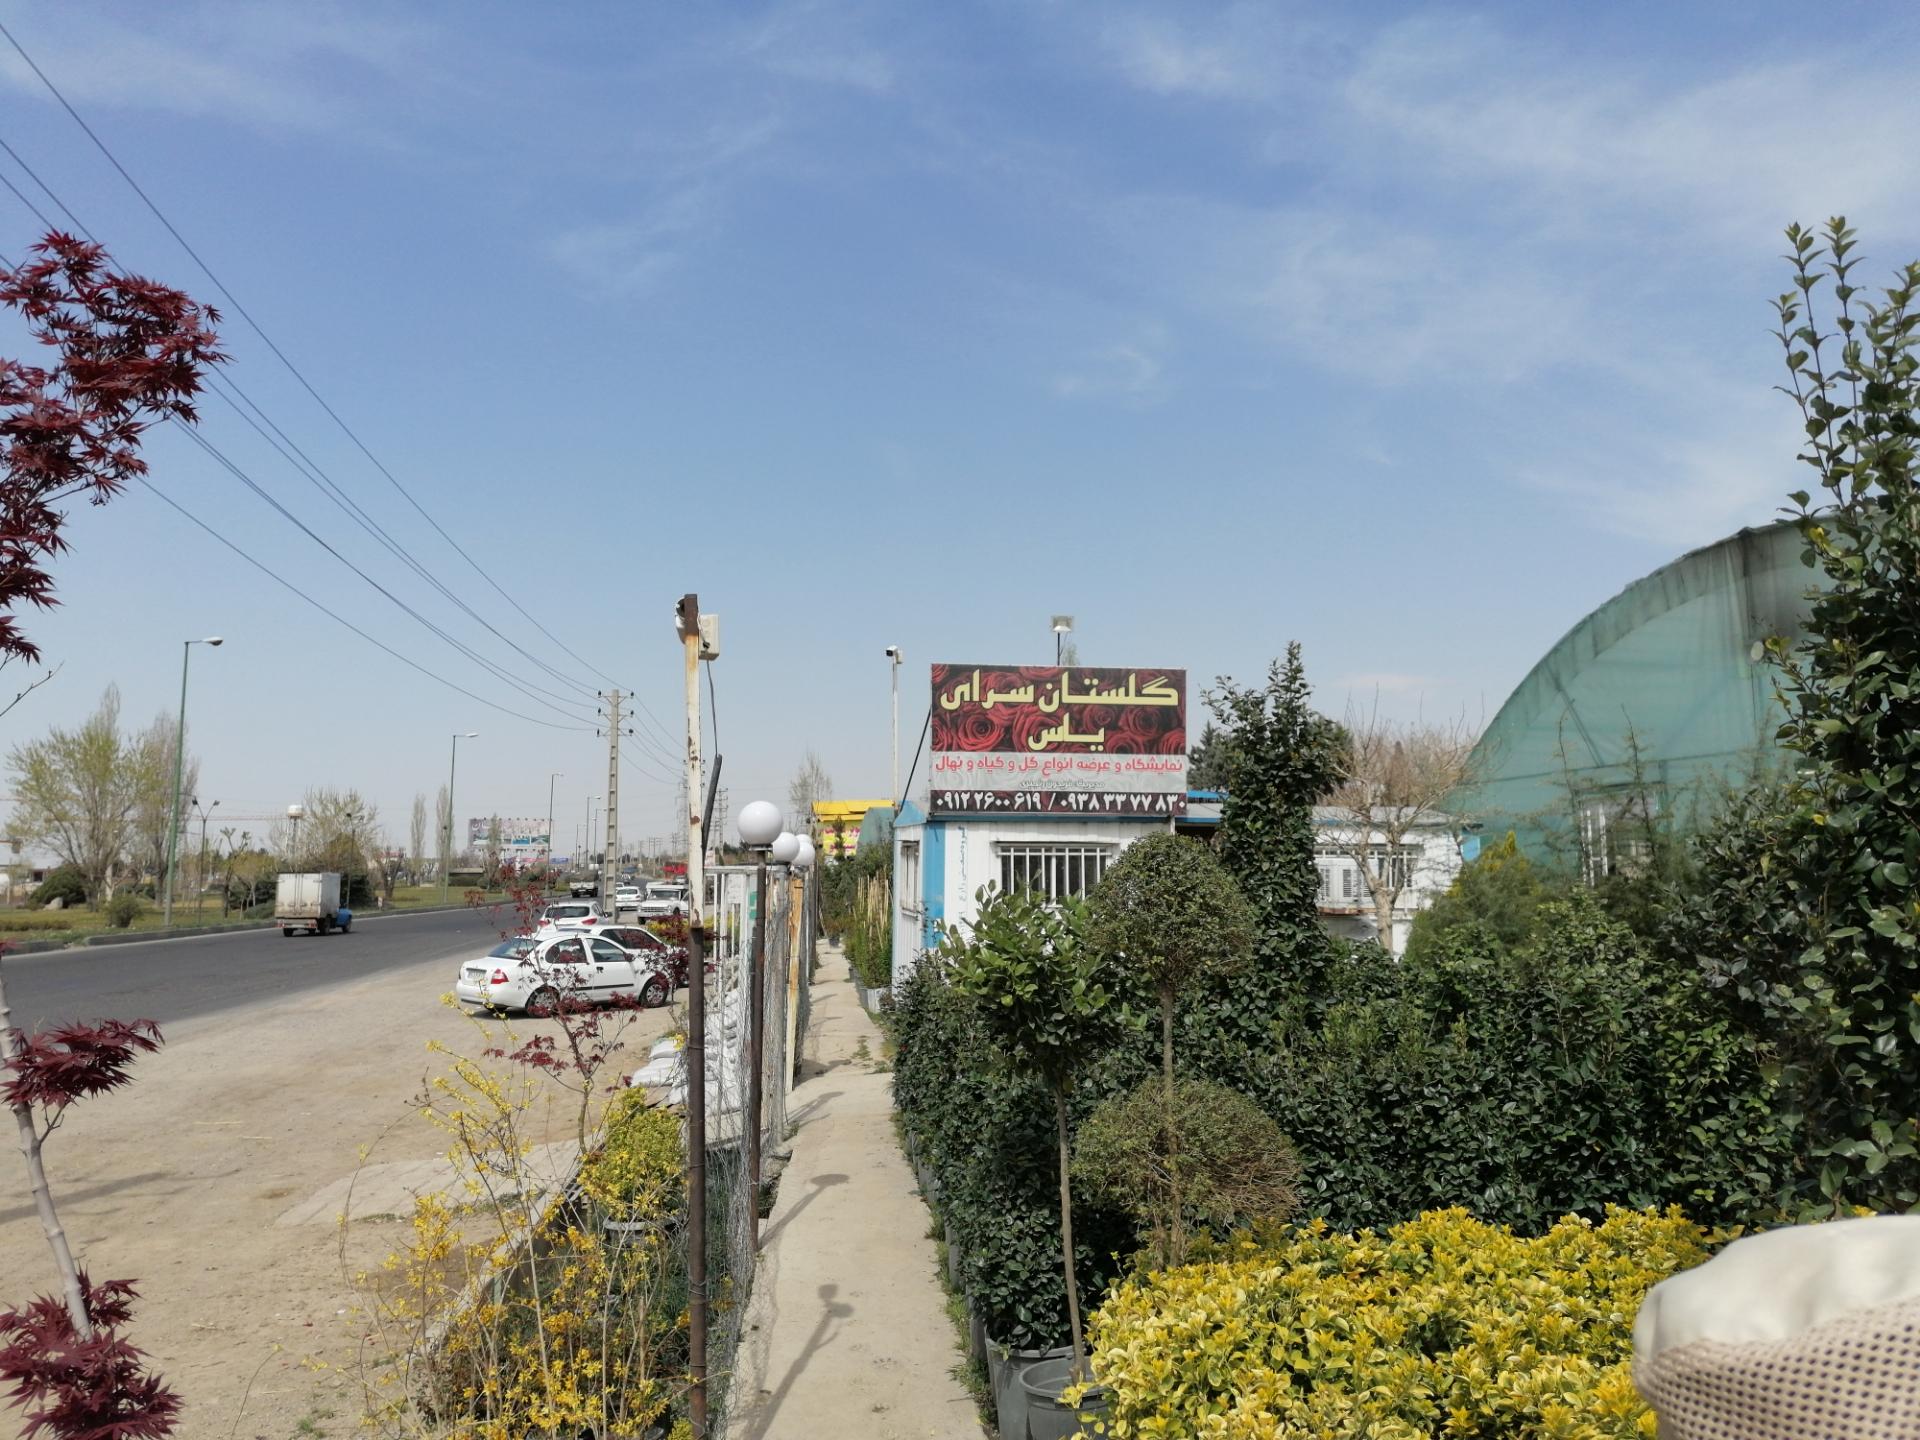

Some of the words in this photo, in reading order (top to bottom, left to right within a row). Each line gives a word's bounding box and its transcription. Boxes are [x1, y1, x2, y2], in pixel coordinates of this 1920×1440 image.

[939, 668, 1035, 710] سرای
[1038, 671, 1179, 713] گلستان
[1027, 712, 1105, 751] یاس
[935, 756, 963, 771] نهال
[967, 757, 974, 771] و
[1008, 757, 1015, 772] و
[1041, 757, 1073, 776] انواع
[1077, 758, 1110, 774] عرضه
[1114, 761, 1121, 773] و
[1125, 757, 1183, 774] نمایشگاه
[936, 791, 970, 810] ۰۹۱۲
[974, 791, 1010, 810] ۲۶۰۰
[1014, 792, 1041, 810] ۶۱۹
[1060, 792, 1100, 810] ۰۹۳۸
[1103, 793, 1127, 811] ۳۳
[1130, 794, 1152, 811] ۷۷
[1155, 794, 1186, 811] ۸۳۰
